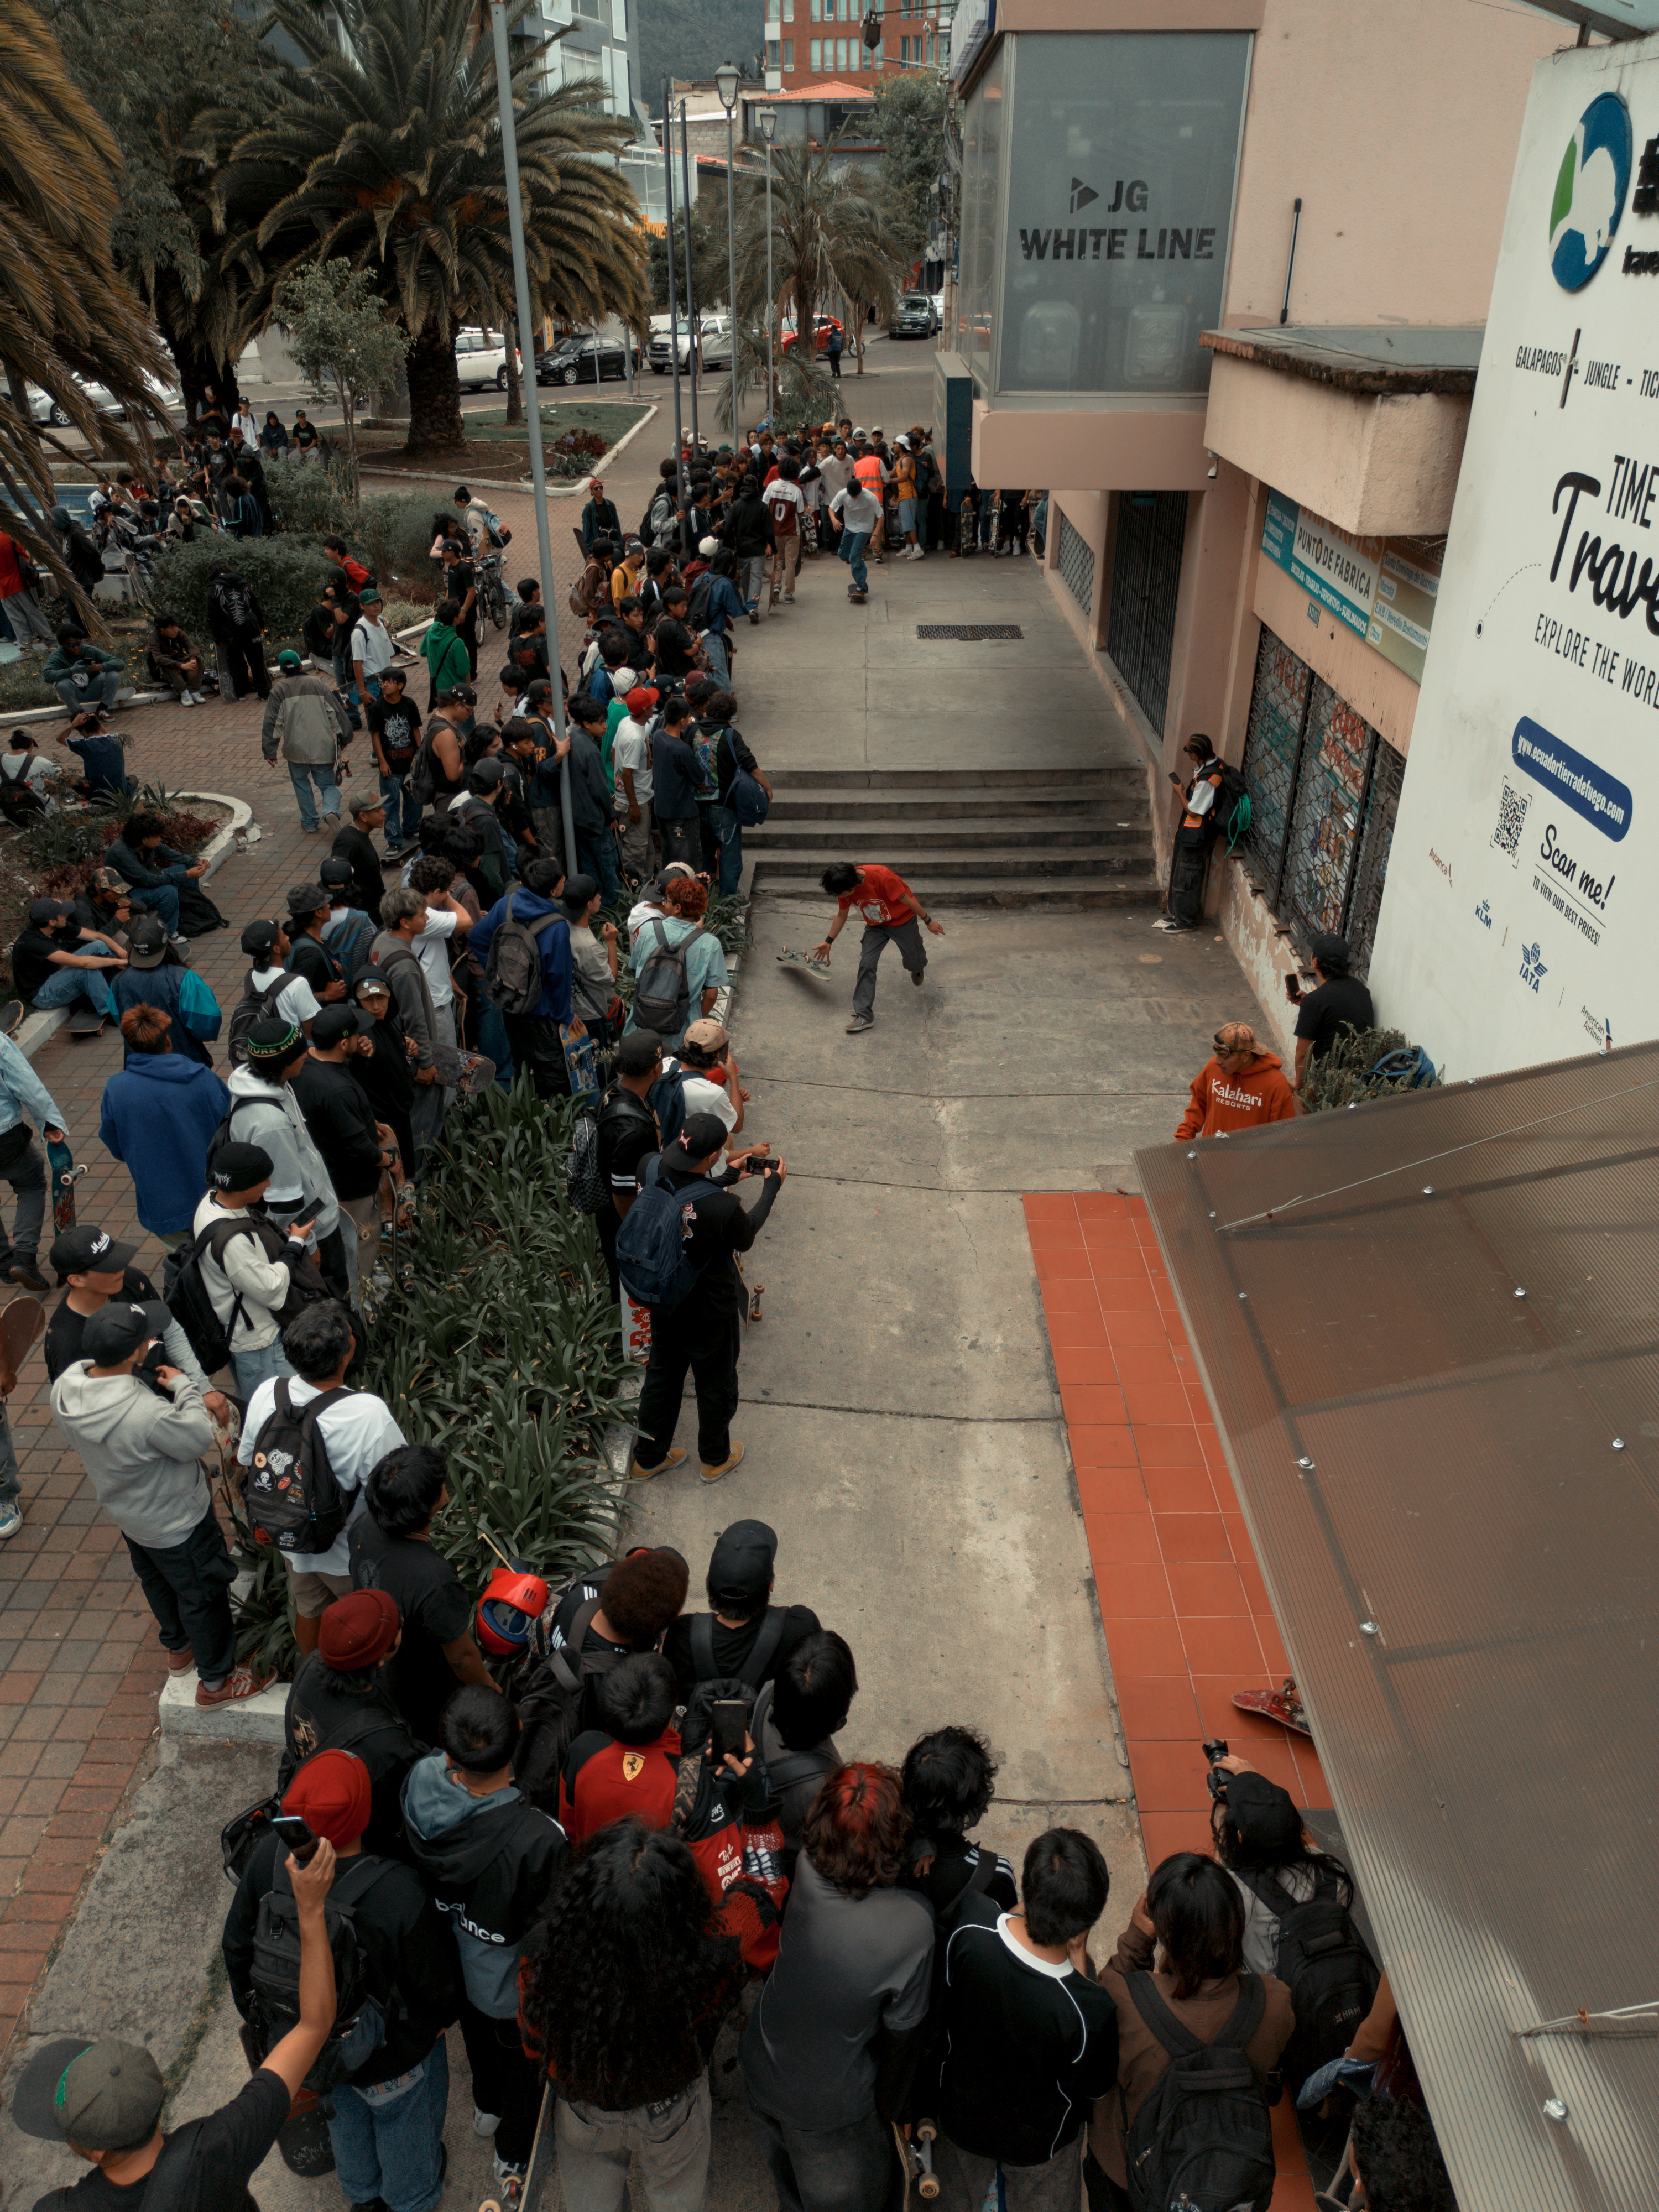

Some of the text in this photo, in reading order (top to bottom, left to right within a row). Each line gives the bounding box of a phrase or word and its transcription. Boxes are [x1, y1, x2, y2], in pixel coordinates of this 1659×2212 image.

[1108, 180, 1149, 213] JG
[1019, 228, 1216, 260] WHITE LINE
[1515, 345, 1563, 377] GALAPAGOS
[1584, 361, 1621, 390] JUNGLE
[1640, 369, 1659, 399] TIC
[1606, 455, 1659, 529] TIME
[775, 503, 786, 521] 0
[1297, 526, 1323, 564] PUNTO
[1322, 545, 1334, 571] DE
[1334, 554, 1371, 599] FABRICA
[1396, 560, 1414, 581] Domingo
[1415, 571, 1420, 583] de
[1291, 562, 1304, 582] ESCOLAR
[1306, 574, 1319, 594] TRABAJO
[1321, 587, 1340, 612] DEPORTIVO
[1341, 605, 1367, 634] SUBLIMADOS
[1379, 578, 1394, 598] Marista
[1370, 625, 1380, 643] Otros
[1402, 620, 1427, 646] Bustamante
[1535, 613, 1590, 667] EXPLORE
[1592, 642, 1619, 684] THE
[1517, 735, 1625, 825] www.ecuadortierradefuego.com
[1429, 847, 1448, 875] Avianca
[1540, 824, 1615, 910] Scan me!
[1475, 905, 1492, 930] KLM
[1532, 875, 1600, 947] TO VIEW OUR BEST PRICES!
[1519, 963, 1539, 994] IATA
[1581, 1005, 1605, 1036] American
[1583, 1020, 1603, 1045] Airlines
[1212, 1079, 1262, 1107] Kalahari
[1215, 1097, 1251, 1111] RESORTS
[711, 1803, 723, 1818] aws
[717, 1855, 742, 1877] PIRELLI
